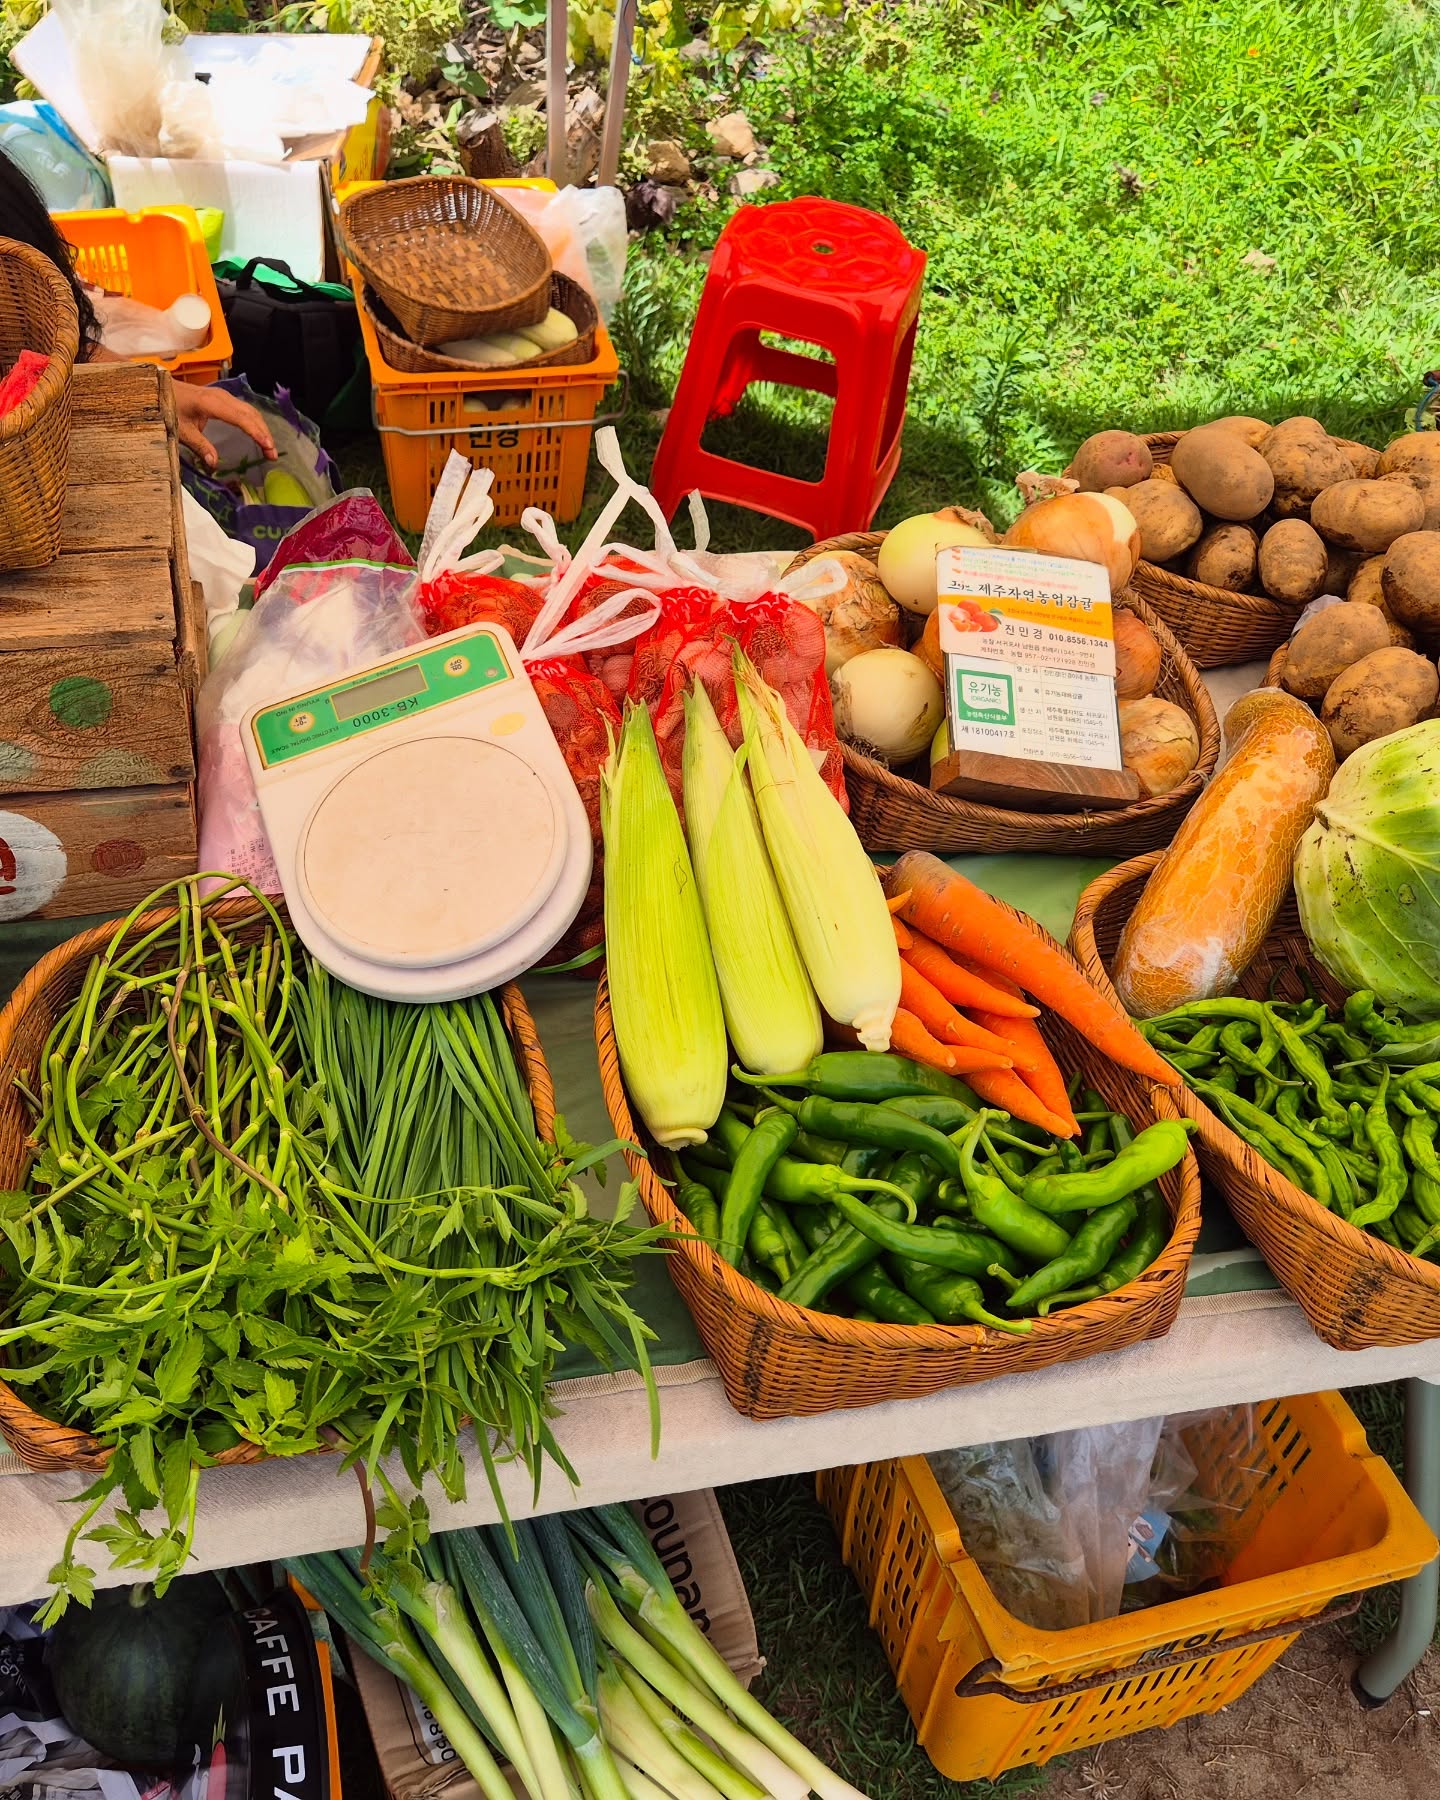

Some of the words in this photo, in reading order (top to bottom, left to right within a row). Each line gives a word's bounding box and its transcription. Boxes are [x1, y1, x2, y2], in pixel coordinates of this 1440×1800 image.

[978, 583, 1093, 611] 제주자연농업감귤
[968, 682, 1002, 697] 유기농
[352, 697, 419, 728] KB-3000
[242, 1608, 300, 1716] CAFFE
